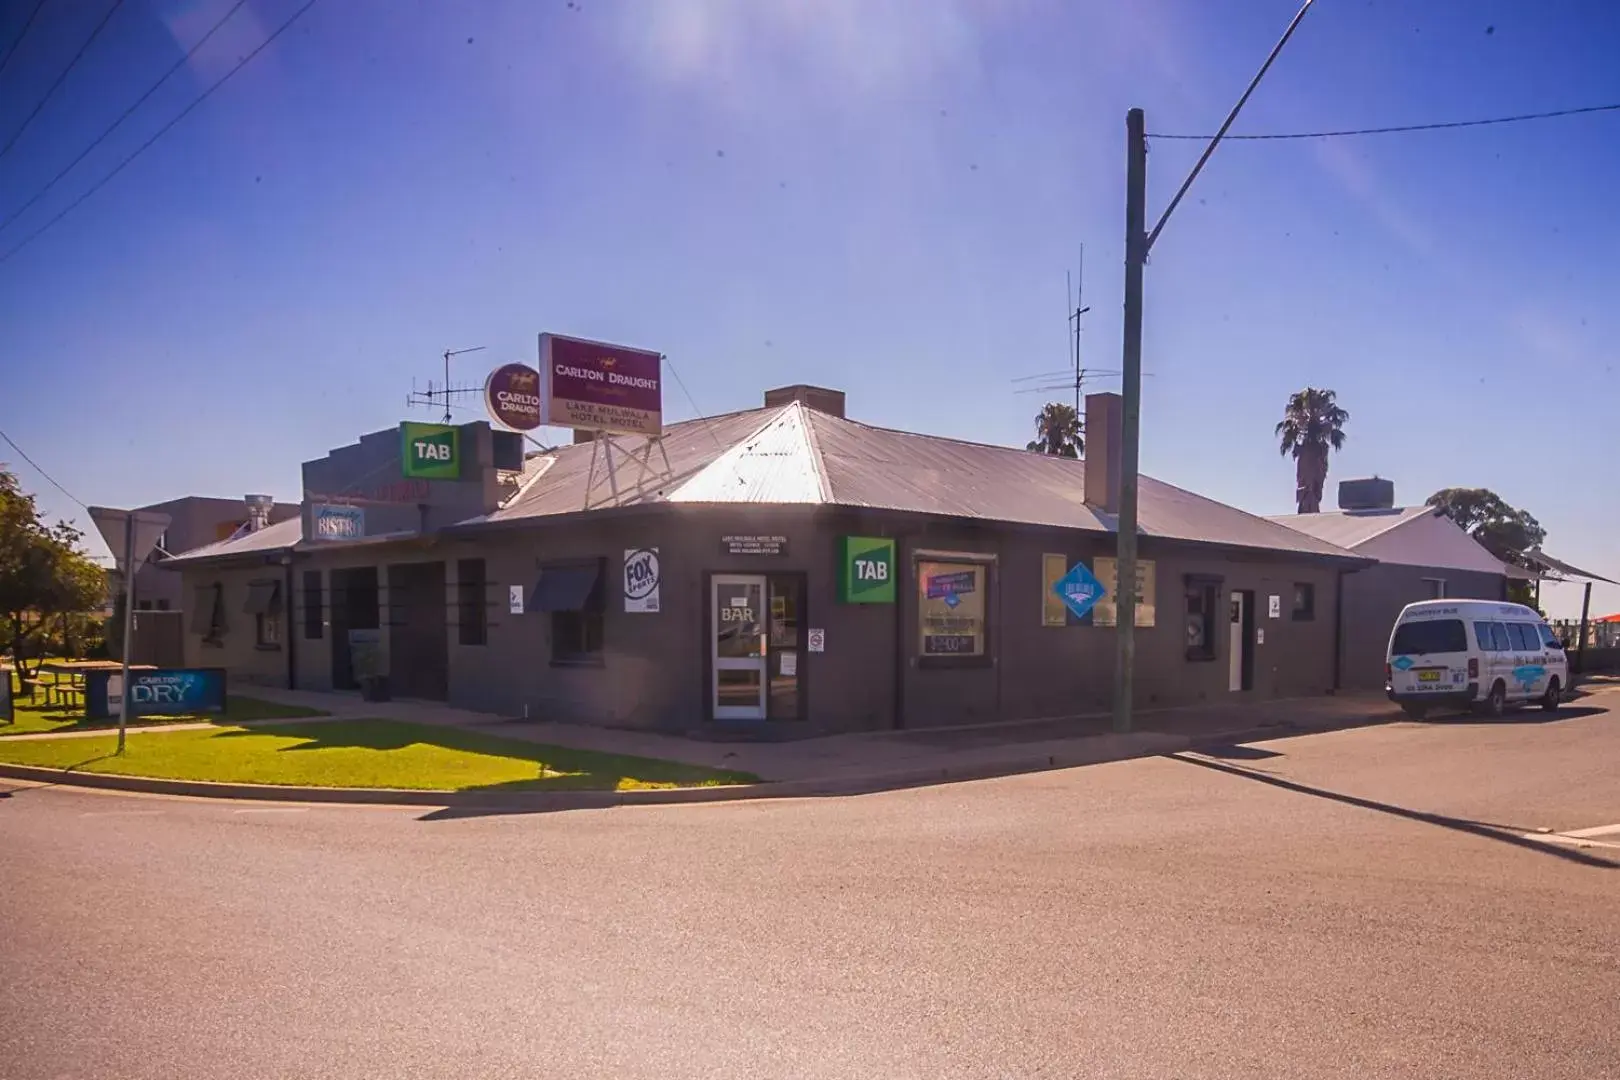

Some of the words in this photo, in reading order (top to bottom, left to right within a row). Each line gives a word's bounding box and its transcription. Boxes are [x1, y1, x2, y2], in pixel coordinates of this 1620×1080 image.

[555, 364, 604, 382] CARLTON
[608, 372, 658, 390] DRAUGHT
[497, 391, 540, 405] CARLTO
[501, 402, 540, 414] DRAUGH
[566, 401, 595, 412] LAKE
[598, 406, 650, 420] MULWALA
[570, 412, 607, 424] HOTEL
[610, 417, 645, 429] MOTEL
[414, 442, 451, 460] TAB
[318, 518, 363, 536] BISTRO
[626, 555, 653, 586] FOX
[855, 560, 888, 580] TAB
[628, 576, 656, 593] SPORTS
[721, 607, 754, 622] BAR
[138, 676, 181, 685] CARLTON
[131, 684, 192, 703] DRY
